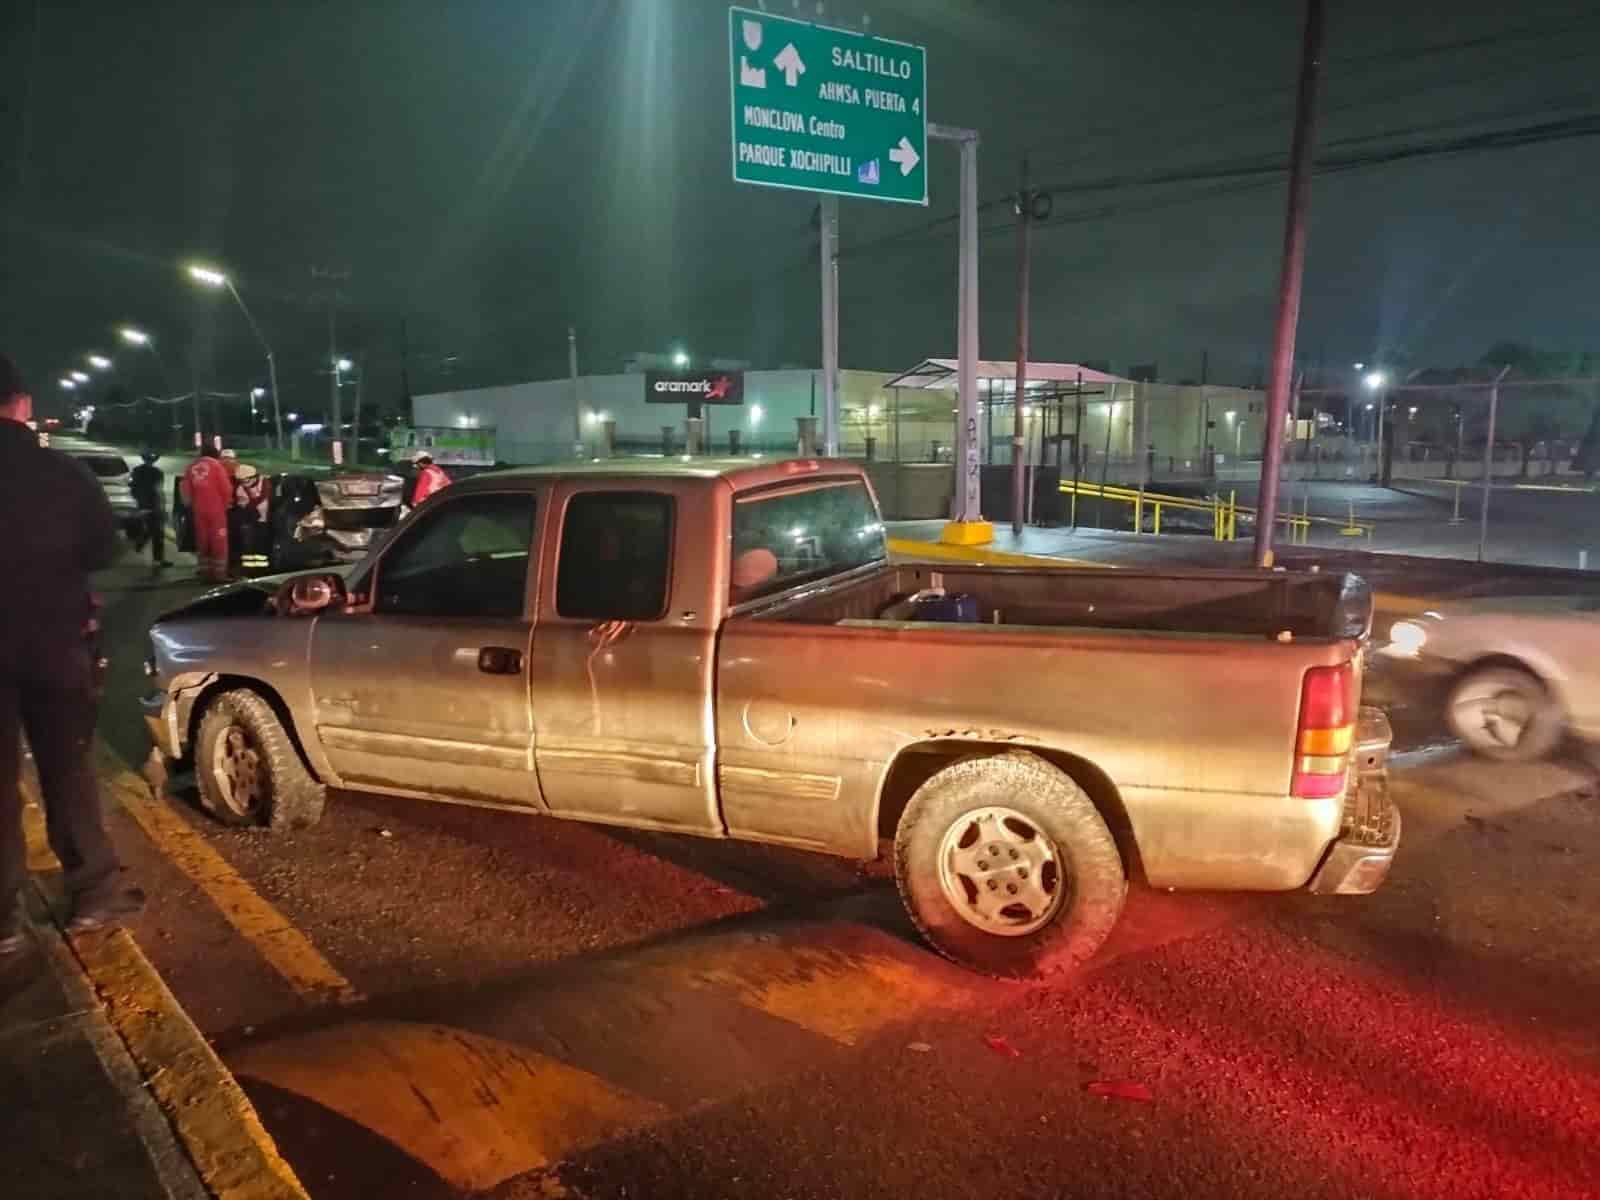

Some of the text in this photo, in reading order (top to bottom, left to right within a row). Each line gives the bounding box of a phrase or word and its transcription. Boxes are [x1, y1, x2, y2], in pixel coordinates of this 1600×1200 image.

[831, 46, 911, 80] SALTILLO
[818, 82, 920, 116] AHMSA PUERTA 4
[743, 104, 845, 140] MONCLOVA Centro
[739, 142, 851, 177] PARQUE XOCHIPILLI
[654, 380, 712, 392] aramark
